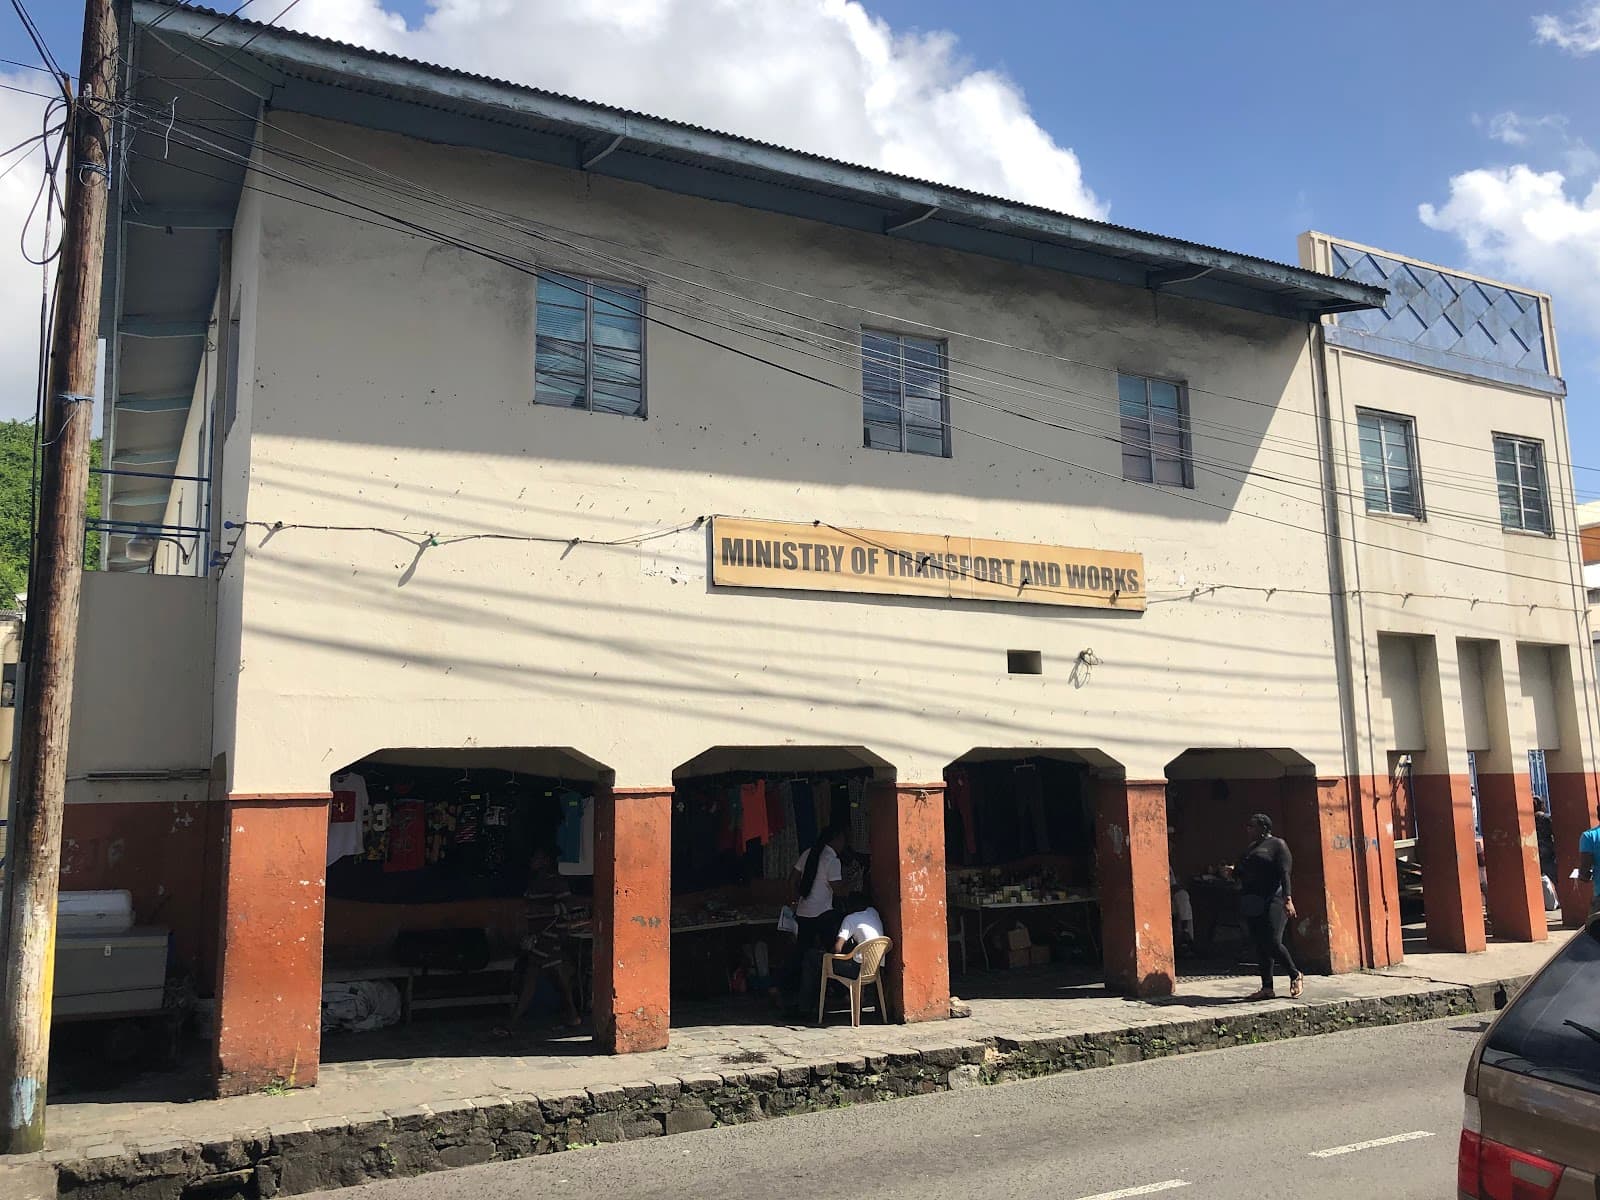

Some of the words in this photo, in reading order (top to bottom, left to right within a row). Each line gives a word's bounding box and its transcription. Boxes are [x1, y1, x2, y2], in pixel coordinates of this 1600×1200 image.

[721, 537, 845, 573] MINISTRY
[851, 546, 879, 575] OF
[884, 549, 1015, 584] TRANSPORT
[1019, 559, 1061, 588] AND
[1065, 563, 1139, 593] WORKS
